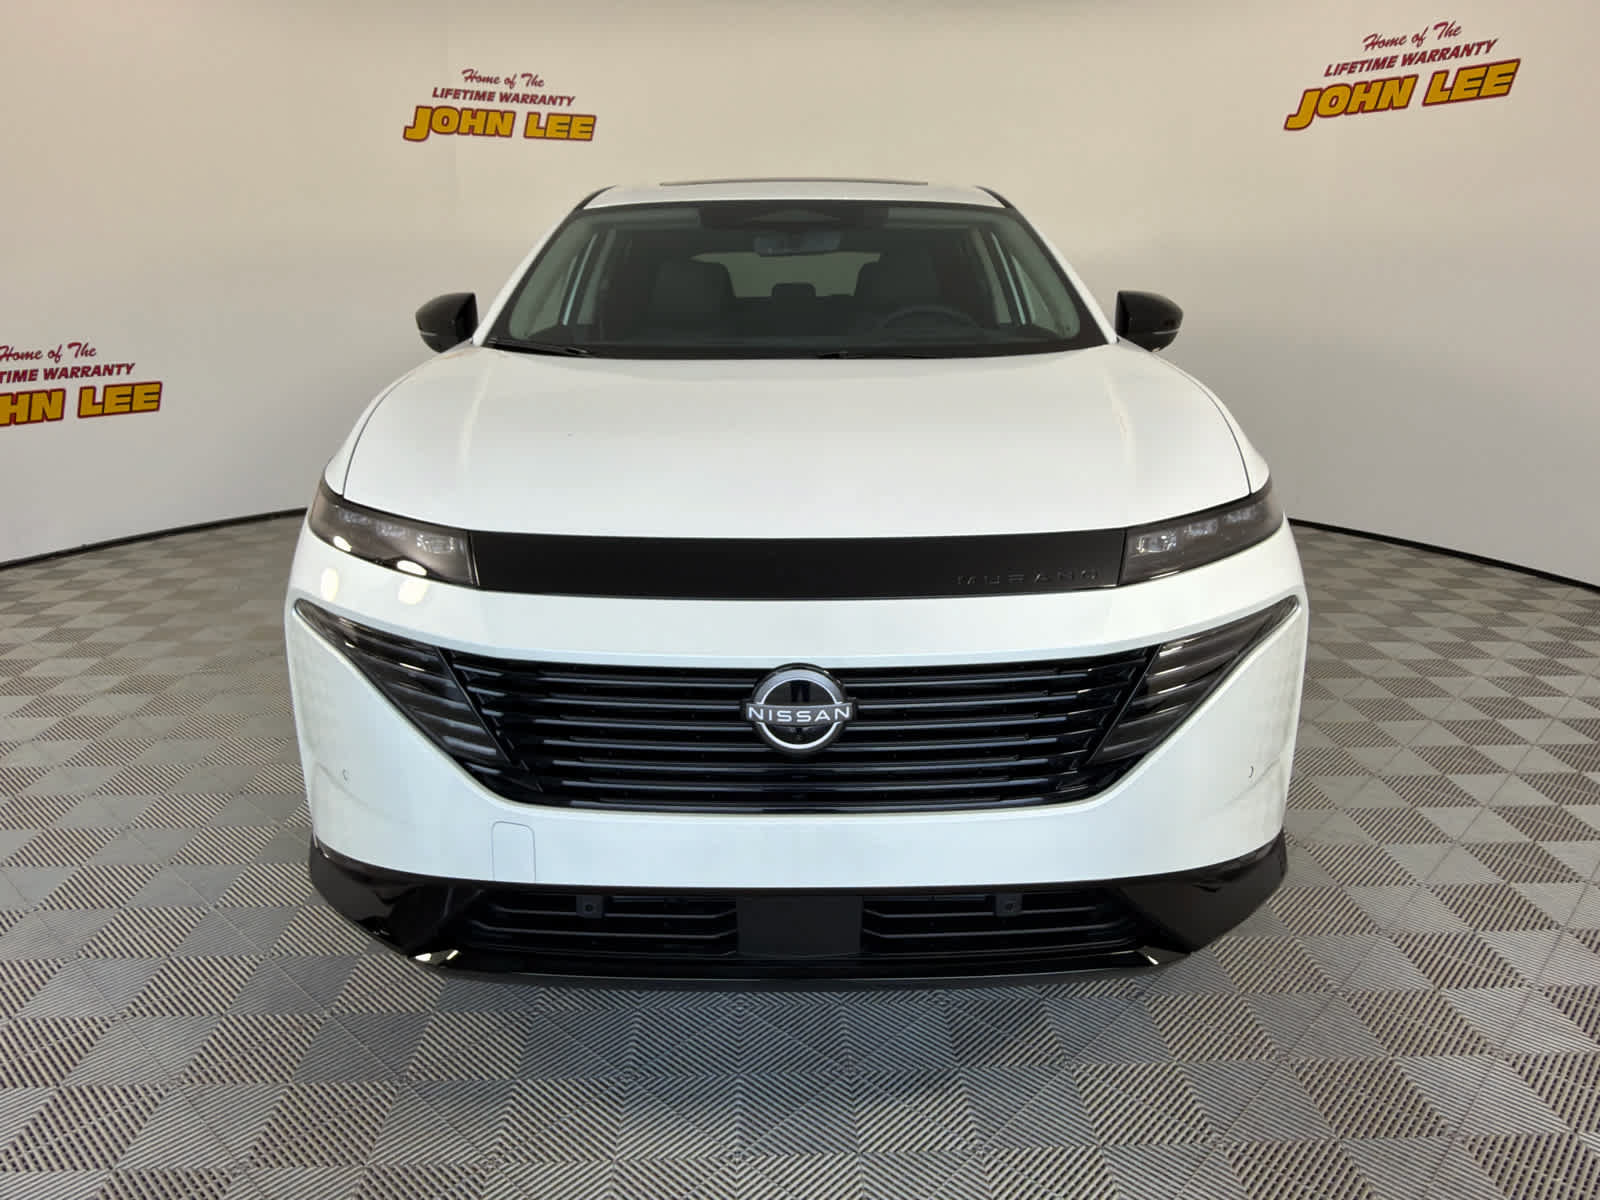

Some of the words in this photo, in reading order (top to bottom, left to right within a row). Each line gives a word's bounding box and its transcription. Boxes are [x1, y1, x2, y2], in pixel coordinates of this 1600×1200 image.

[1362, 33, 1406, 51] Home
[1411, 26, 1429, 47] of
[1432, 20, 1462, 40] The
[1324, 54, 1399, 77] LIFETIME
[1401, 38, 1499, 67] WARRANTY
[462, 68, 500, 85] Home
[504, 73, 517, 88] of
[521, 73, 545, 87] The
[432, 87, 496, 102] LIFETIME
[499, 92, 576, 107] WARRANTY
[1284, 74, 1419, 131] JOHN
[1422, 58, 1521, 107] LEE
[403, 105, 516, 142] JOHN
[523, 112, 597, 141] LEE
[0, 345, 42, 361] Home
[48, 344, 62, 363] of
[67, 342, 97, 358] The
[43, 362, 136, 381] WARRANTY
[77, 381, 163, 418] LEE
[748, 706, 850, 723] NISSAN
